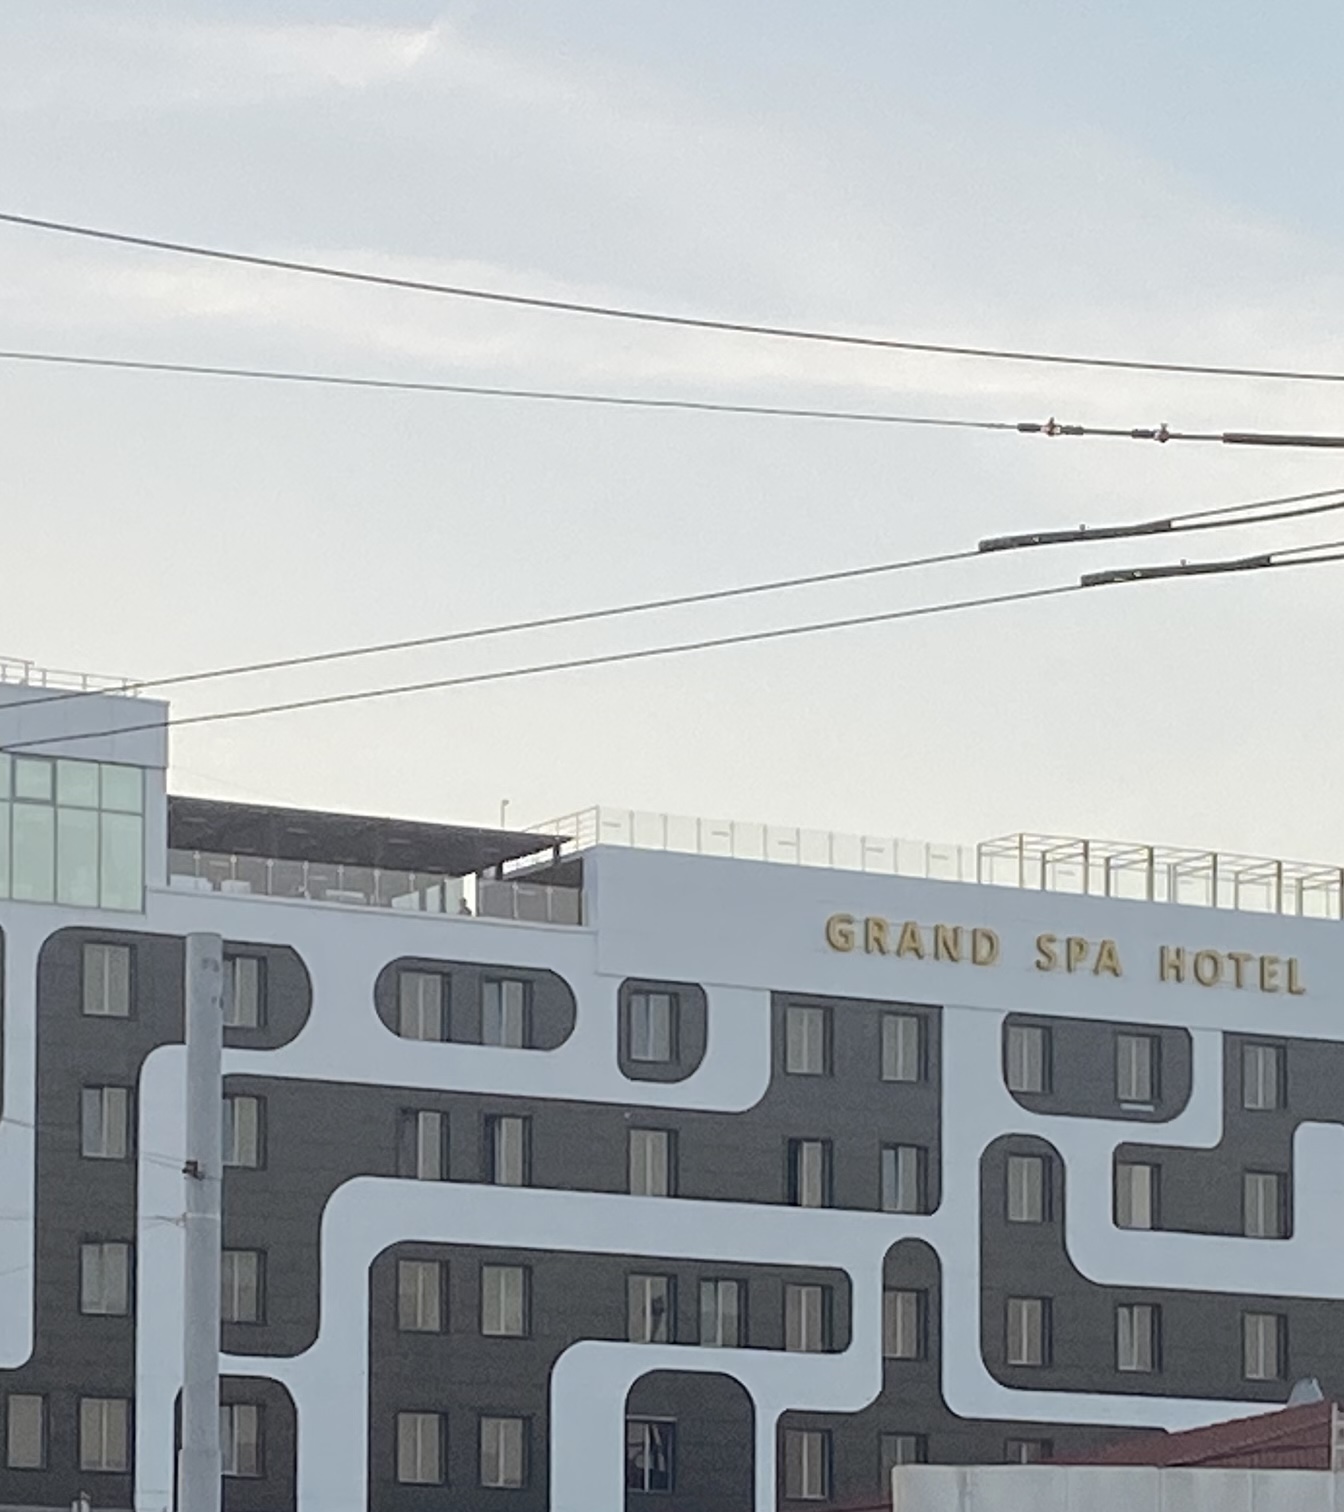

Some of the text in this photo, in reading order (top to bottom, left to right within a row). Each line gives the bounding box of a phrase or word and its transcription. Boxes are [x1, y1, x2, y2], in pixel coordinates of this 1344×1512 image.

[825, 913, 1307, 995] GRAND SPA HOTEL
